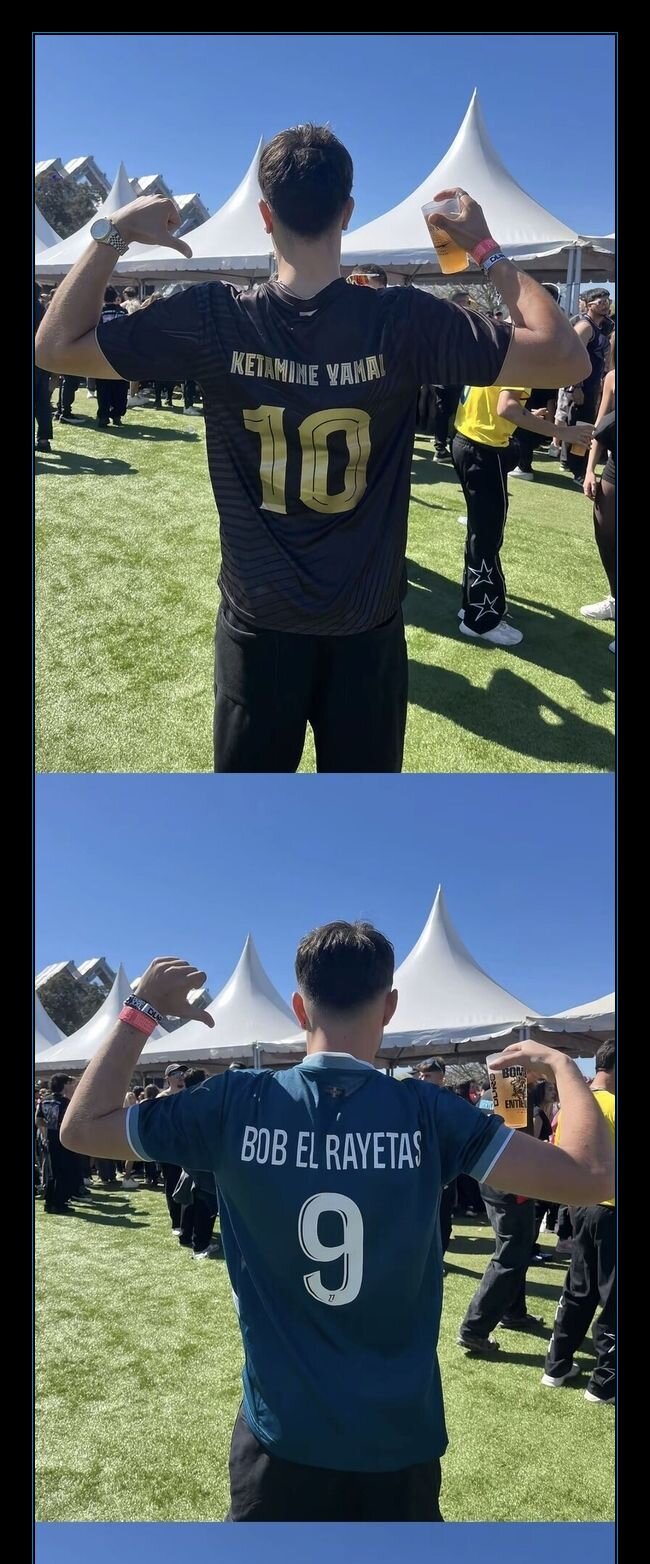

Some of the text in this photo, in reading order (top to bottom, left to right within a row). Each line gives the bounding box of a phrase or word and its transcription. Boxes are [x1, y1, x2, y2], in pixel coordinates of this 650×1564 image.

[231, 351, 386, 386] KETAMINE YAMAL
[243, 405, 371, 514] 10
[241, 1125, 422, 1170] BOB EL RAYETAS
[298, 1192, 364, 1306] 9
